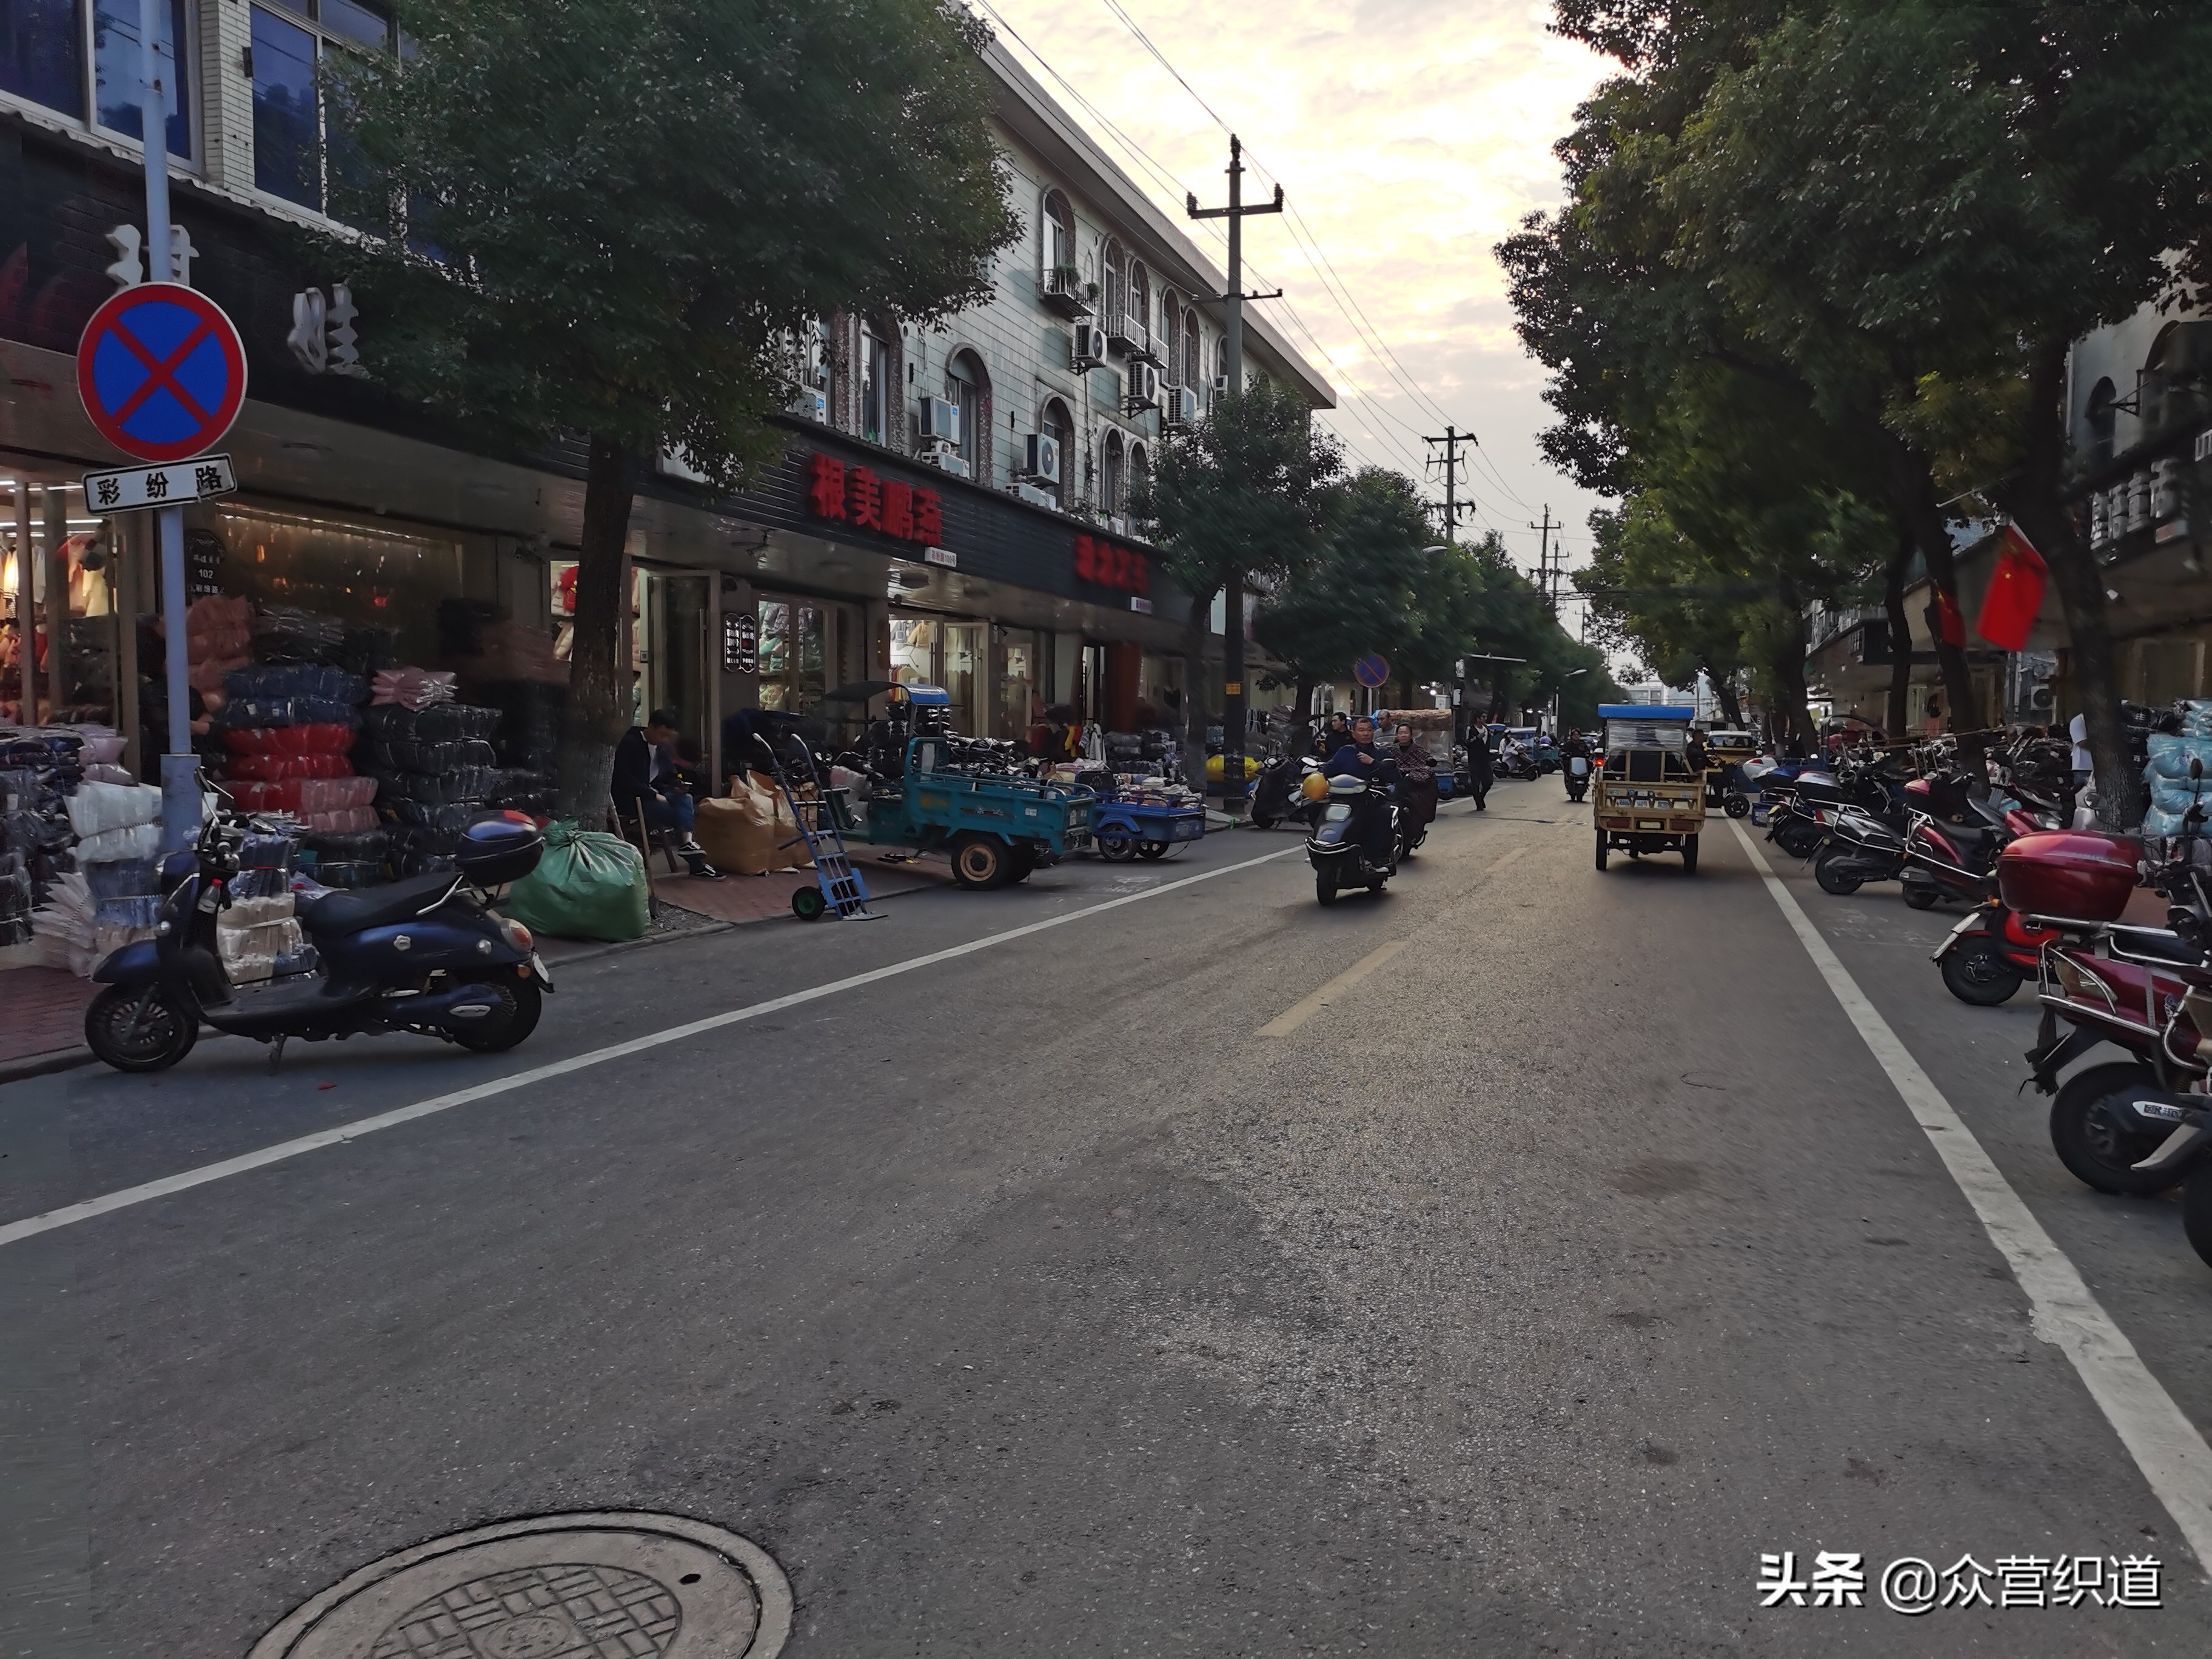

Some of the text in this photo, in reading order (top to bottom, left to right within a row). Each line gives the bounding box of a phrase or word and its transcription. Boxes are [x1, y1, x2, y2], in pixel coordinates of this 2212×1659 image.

[96, 465, 223, 506] 彩纷路
[198, 569, 214, 579] 102
